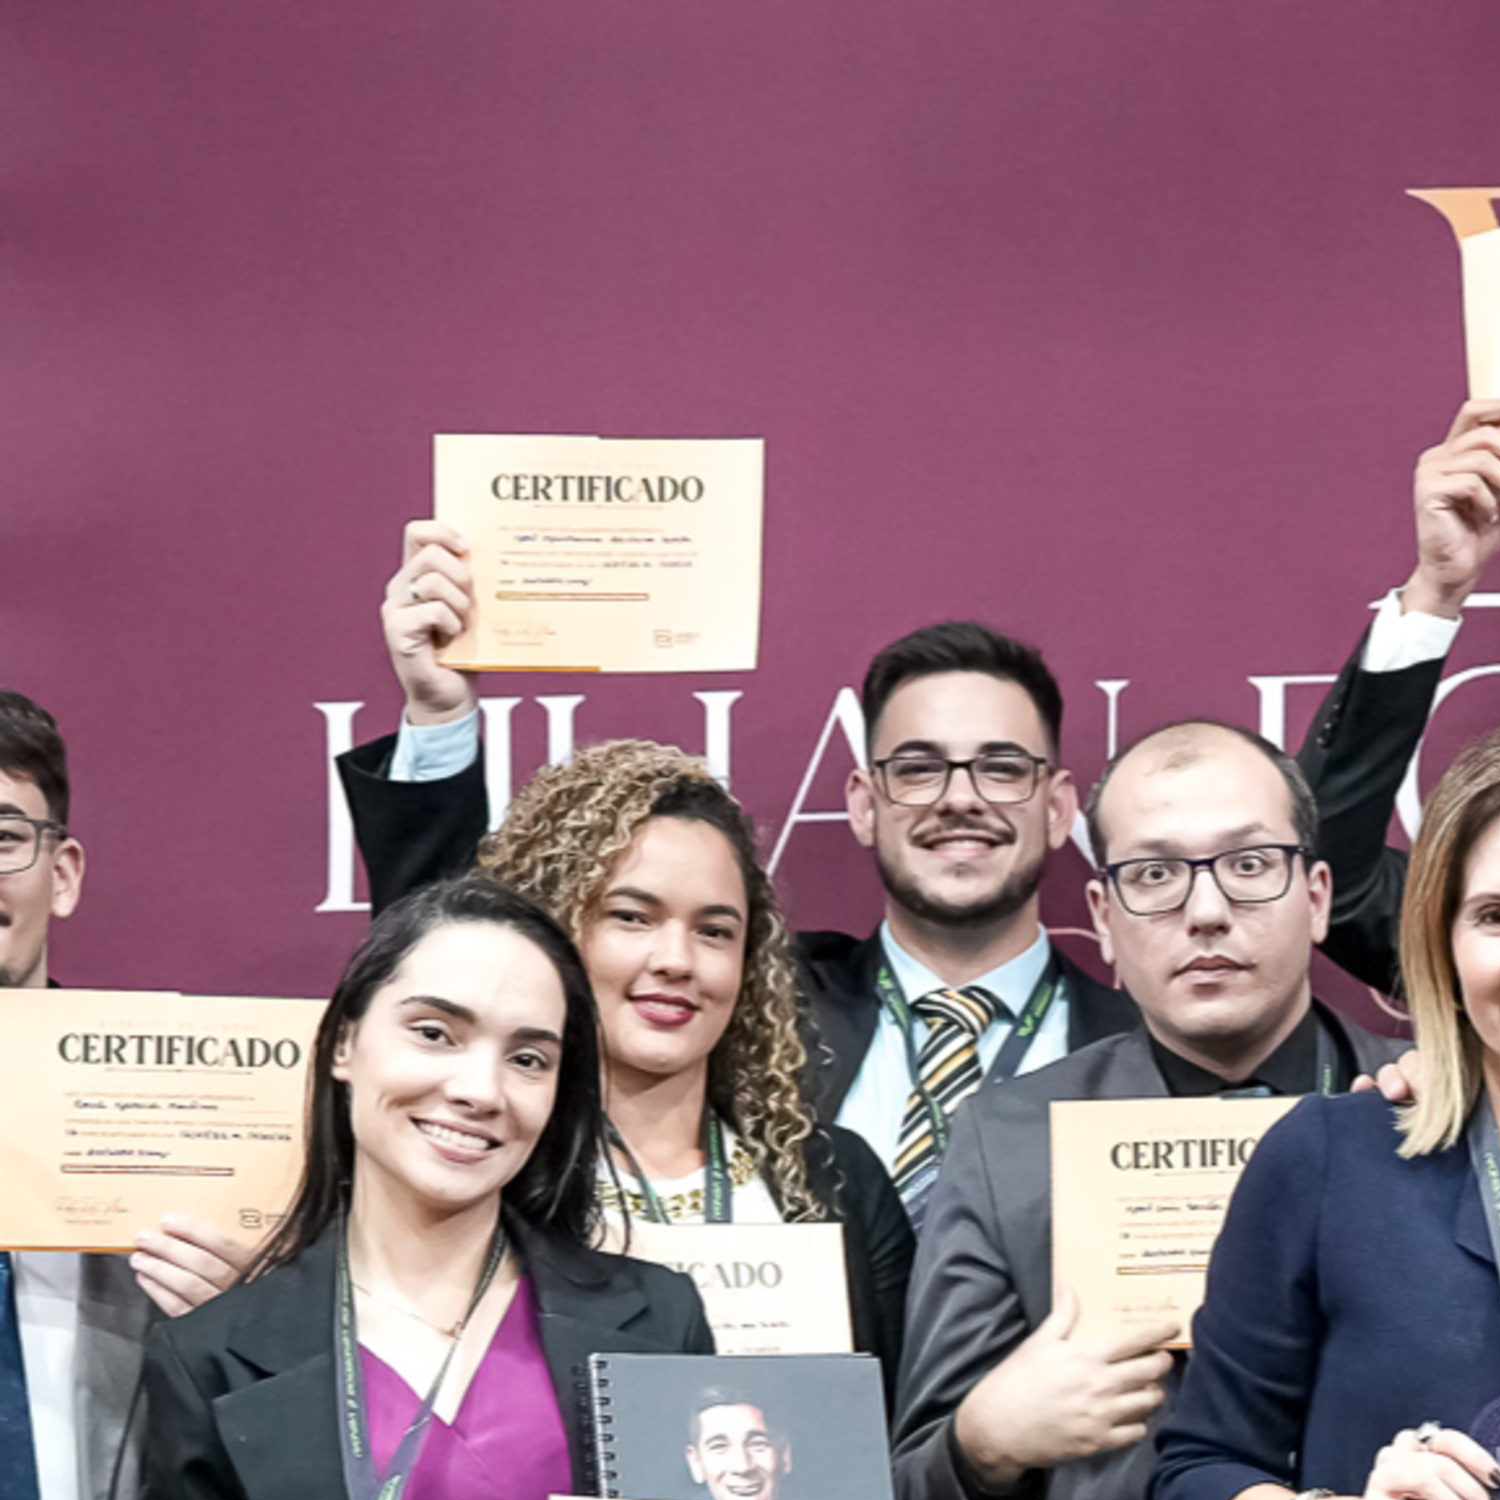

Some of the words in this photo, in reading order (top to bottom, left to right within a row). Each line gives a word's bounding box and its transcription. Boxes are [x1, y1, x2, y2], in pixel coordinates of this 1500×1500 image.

[490, 473, 705, 504] CERTIFICADO
[57, 1032, 301, 1069] CERTIFICADO
[666, 1260, 783, 1290] CADO
